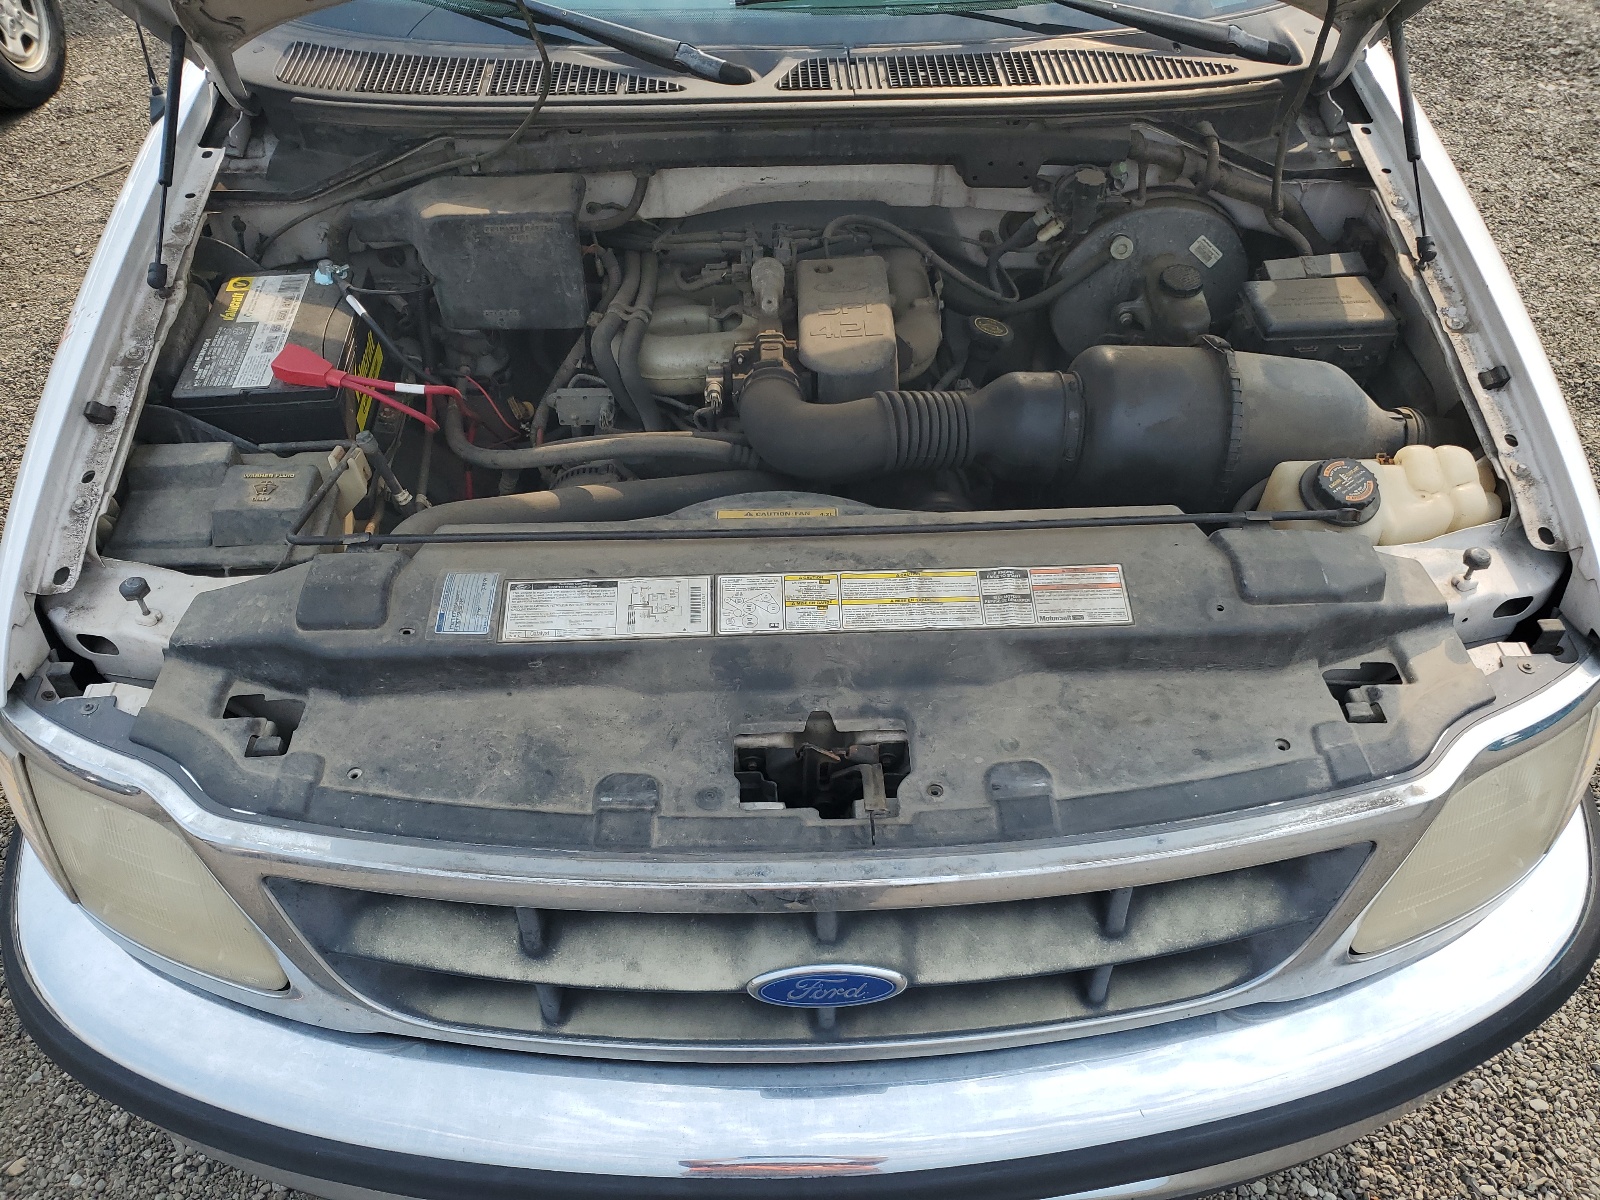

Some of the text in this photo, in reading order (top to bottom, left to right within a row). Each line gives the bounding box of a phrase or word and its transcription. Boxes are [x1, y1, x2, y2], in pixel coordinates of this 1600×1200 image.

[220, 292, 245, 321] Valucraft
[809, 318, 884, 339] 4.2L
[787, 978, 867, 1001] Ford
